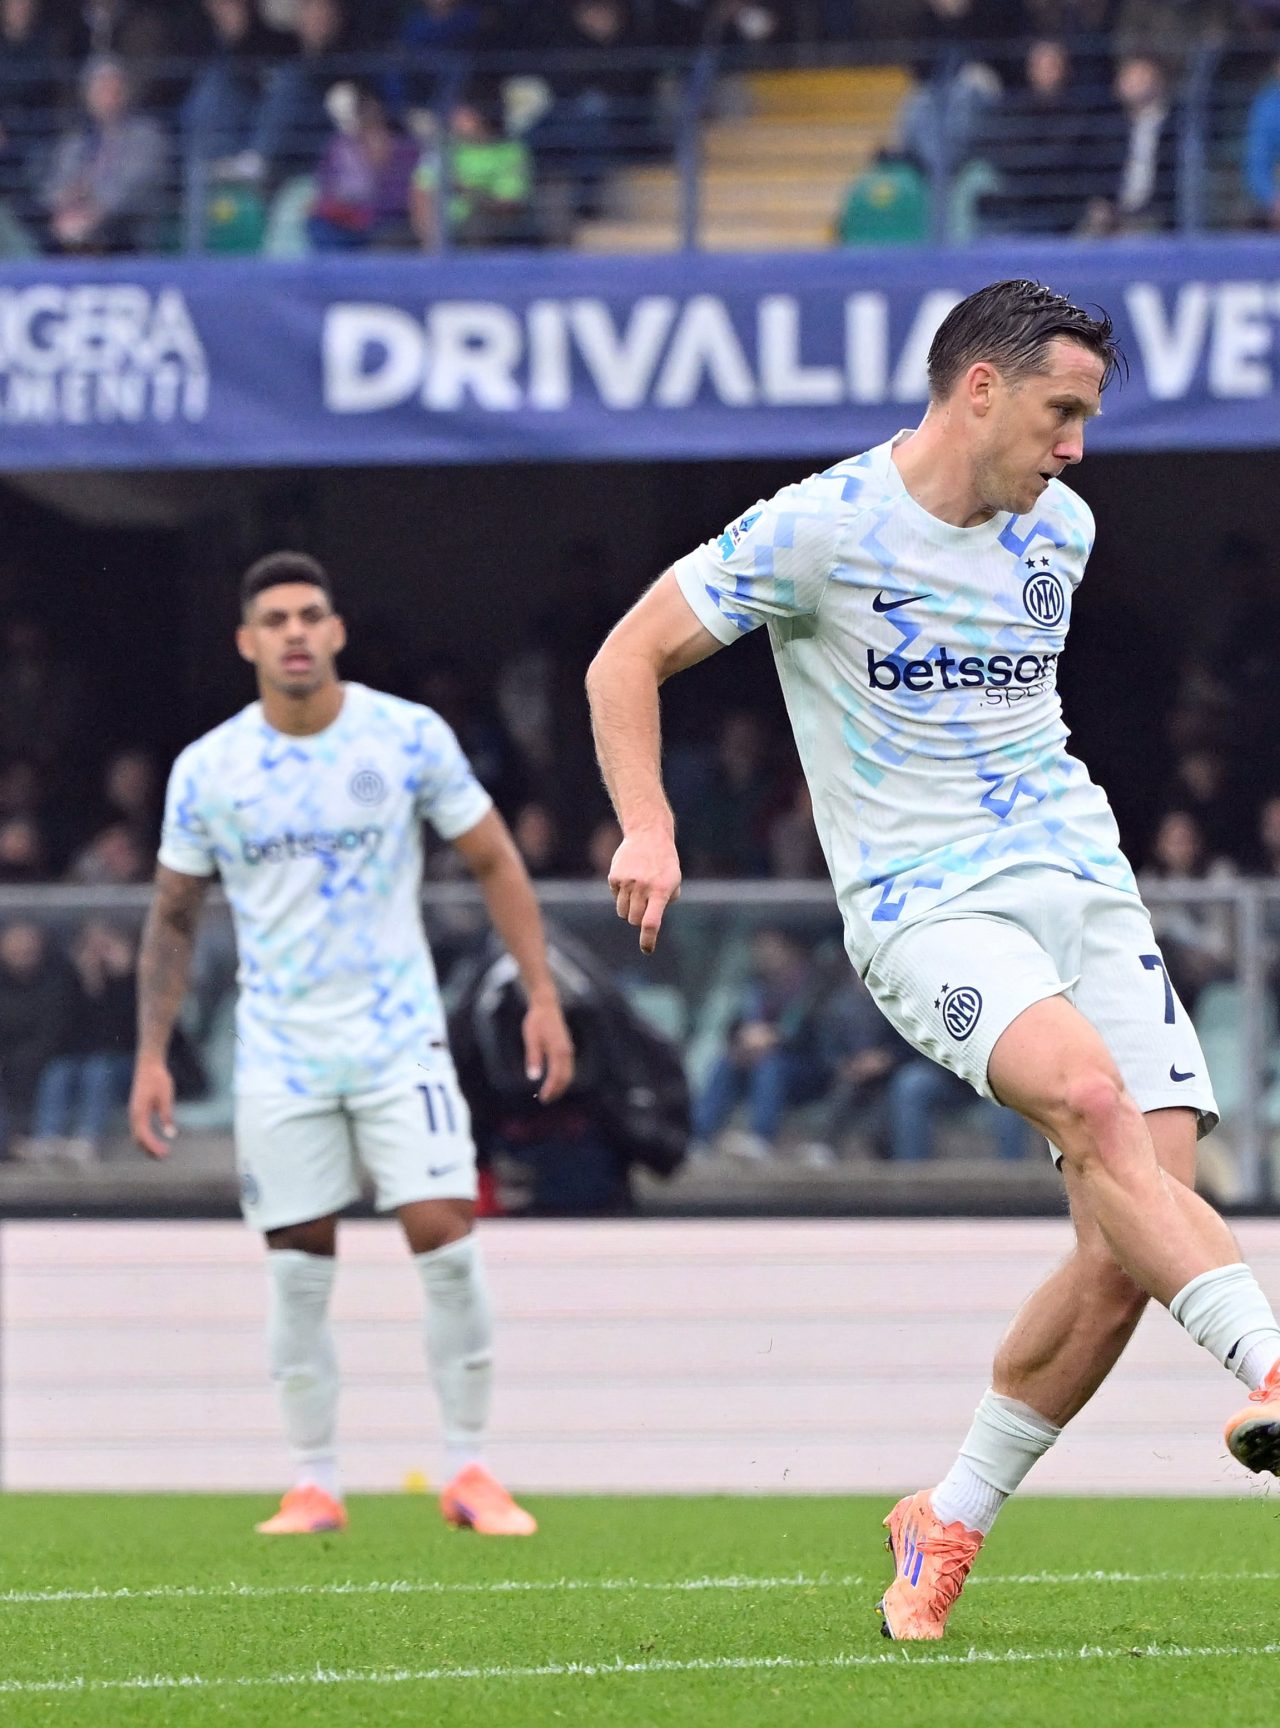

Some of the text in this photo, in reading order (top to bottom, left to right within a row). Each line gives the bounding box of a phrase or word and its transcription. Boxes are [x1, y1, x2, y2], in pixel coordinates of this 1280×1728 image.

[322, 290, 965, 412] DRIVALIA
[1139, 954, 1175, 1024] 7
[415, 1083, 457, 1134] 11
